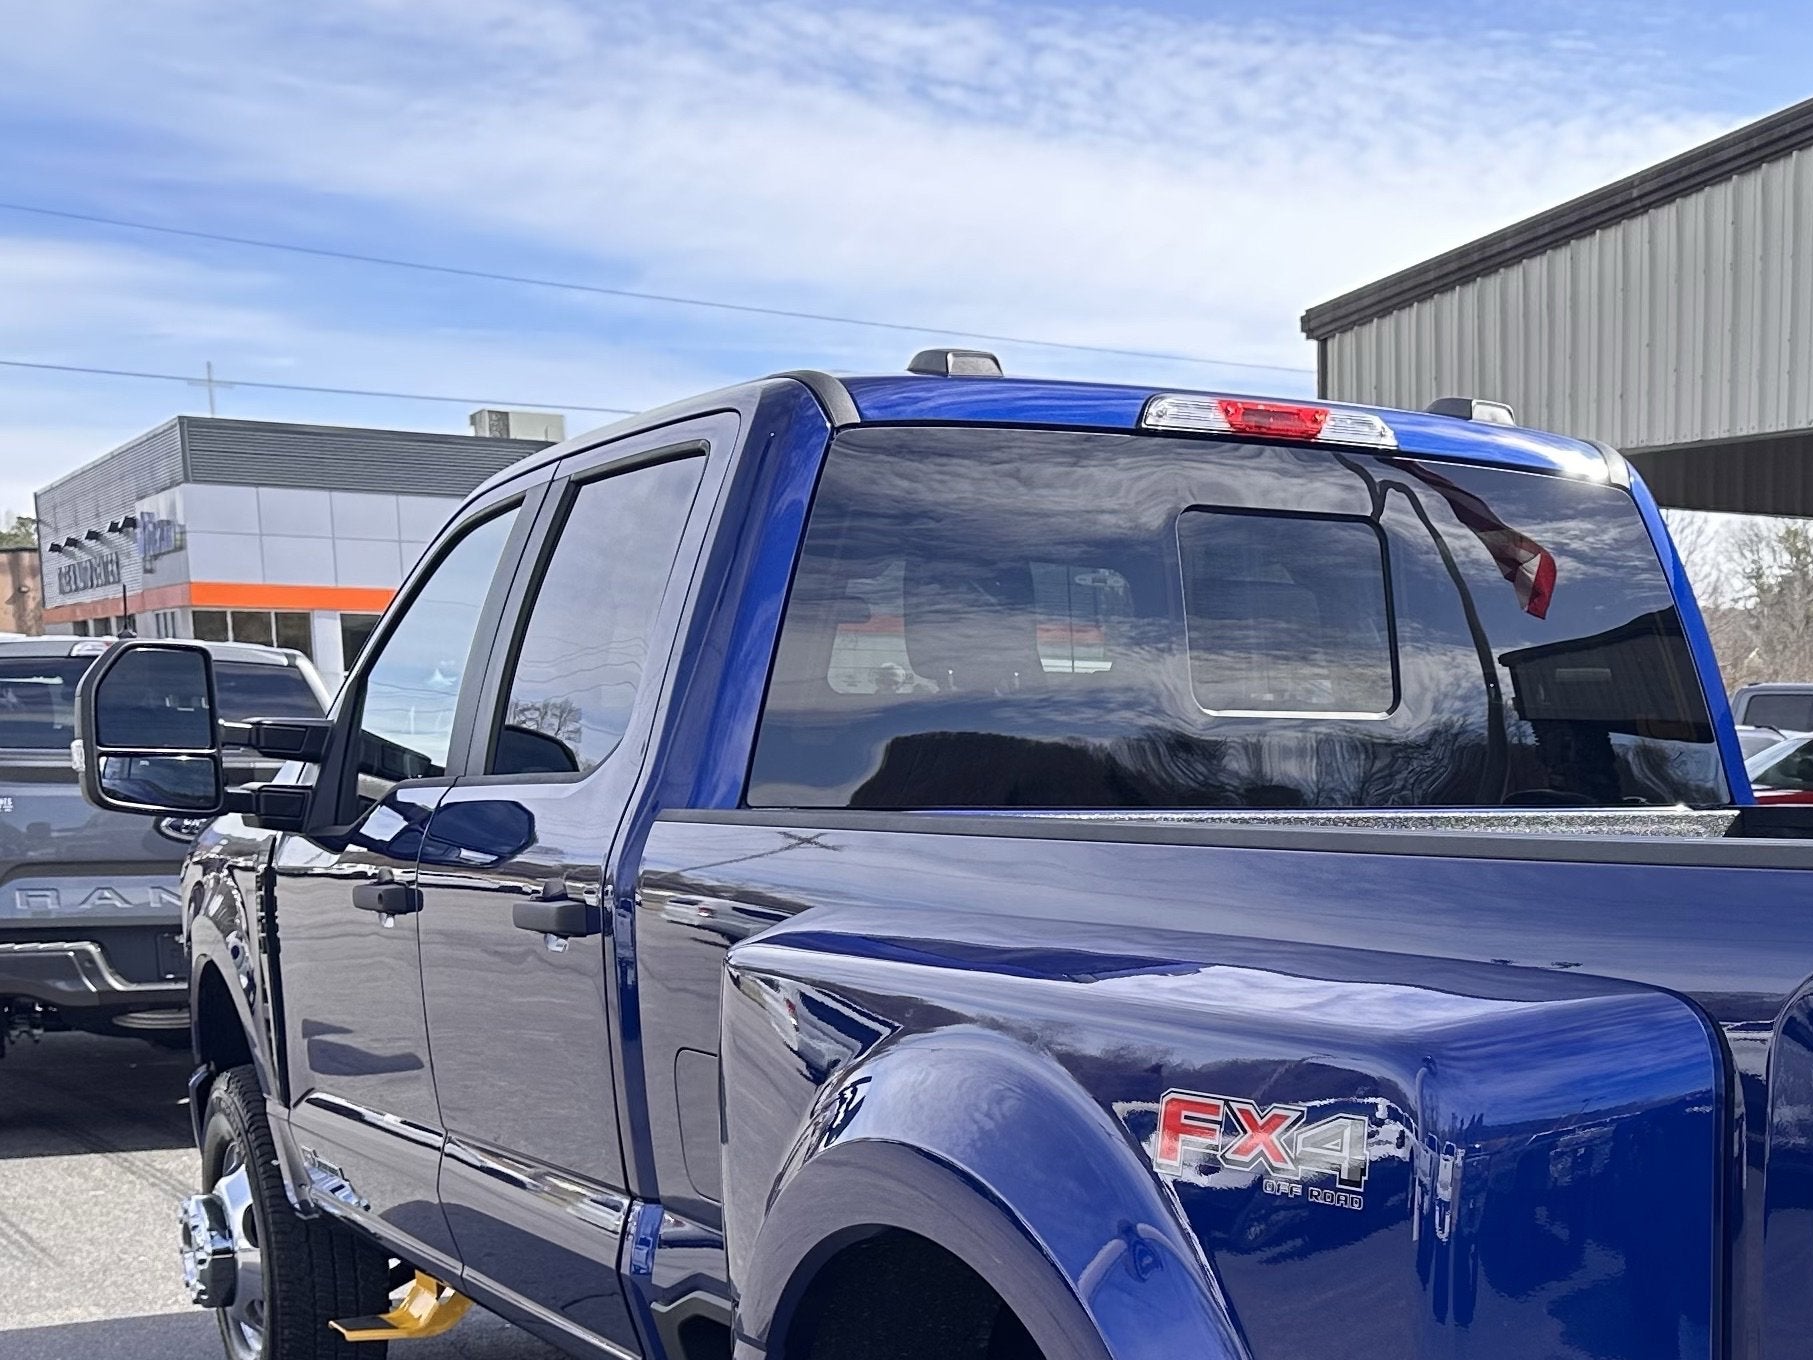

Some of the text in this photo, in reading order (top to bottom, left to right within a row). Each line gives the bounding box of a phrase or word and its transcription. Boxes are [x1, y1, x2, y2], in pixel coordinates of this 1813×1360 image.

[1153, 1087, 1370, 1192] FX4
[1262, 1178, 1364, 1210] OFF ROAD
